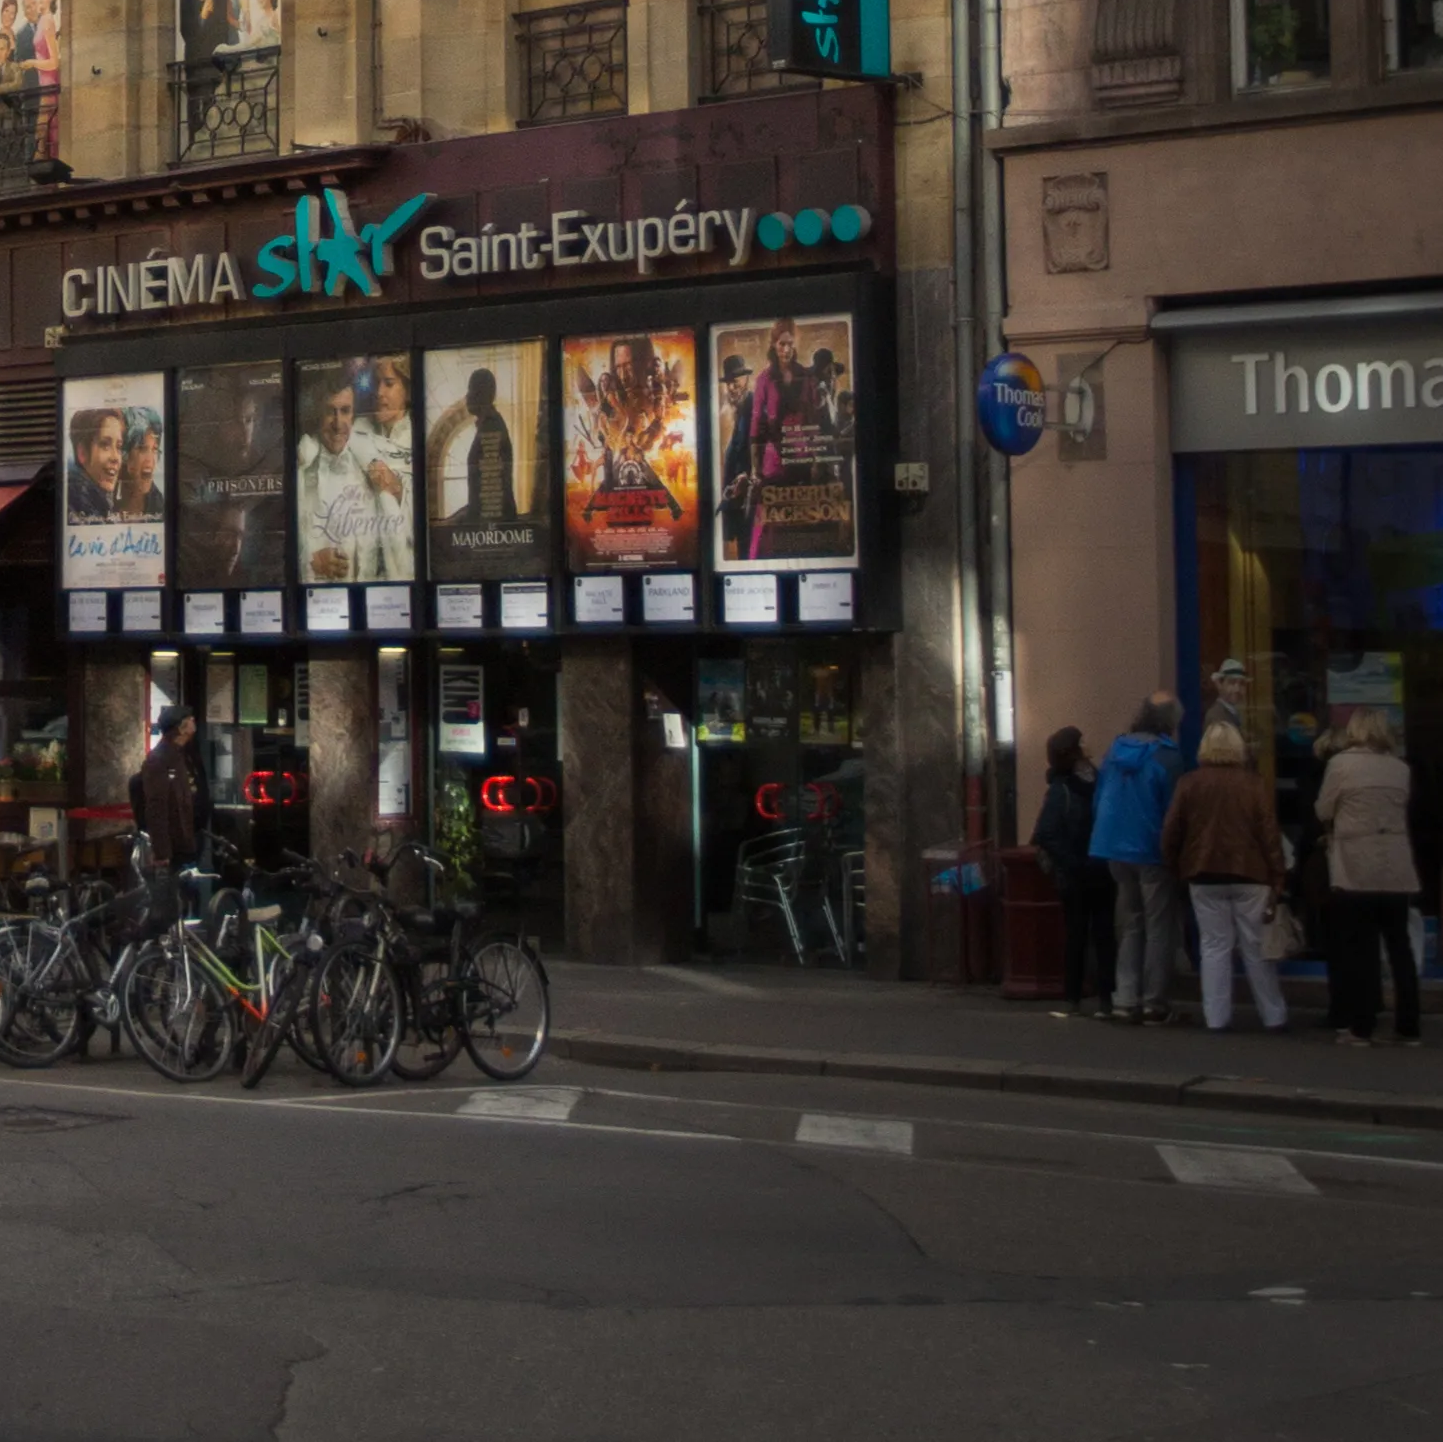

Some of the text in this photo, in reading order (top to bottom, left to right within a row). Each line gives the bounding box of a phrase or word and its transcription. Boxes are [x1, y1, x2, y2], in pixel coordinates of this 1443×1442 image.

[62, 250, 240, 318] CINÉMA
[418, 199, 754, 282] Saint-Exupéry
[207, 477, 283, 494] PRISONERS
[762, 500, 852, 524] JACKSON
[451, 529, 534, 549] MAJORDOME
